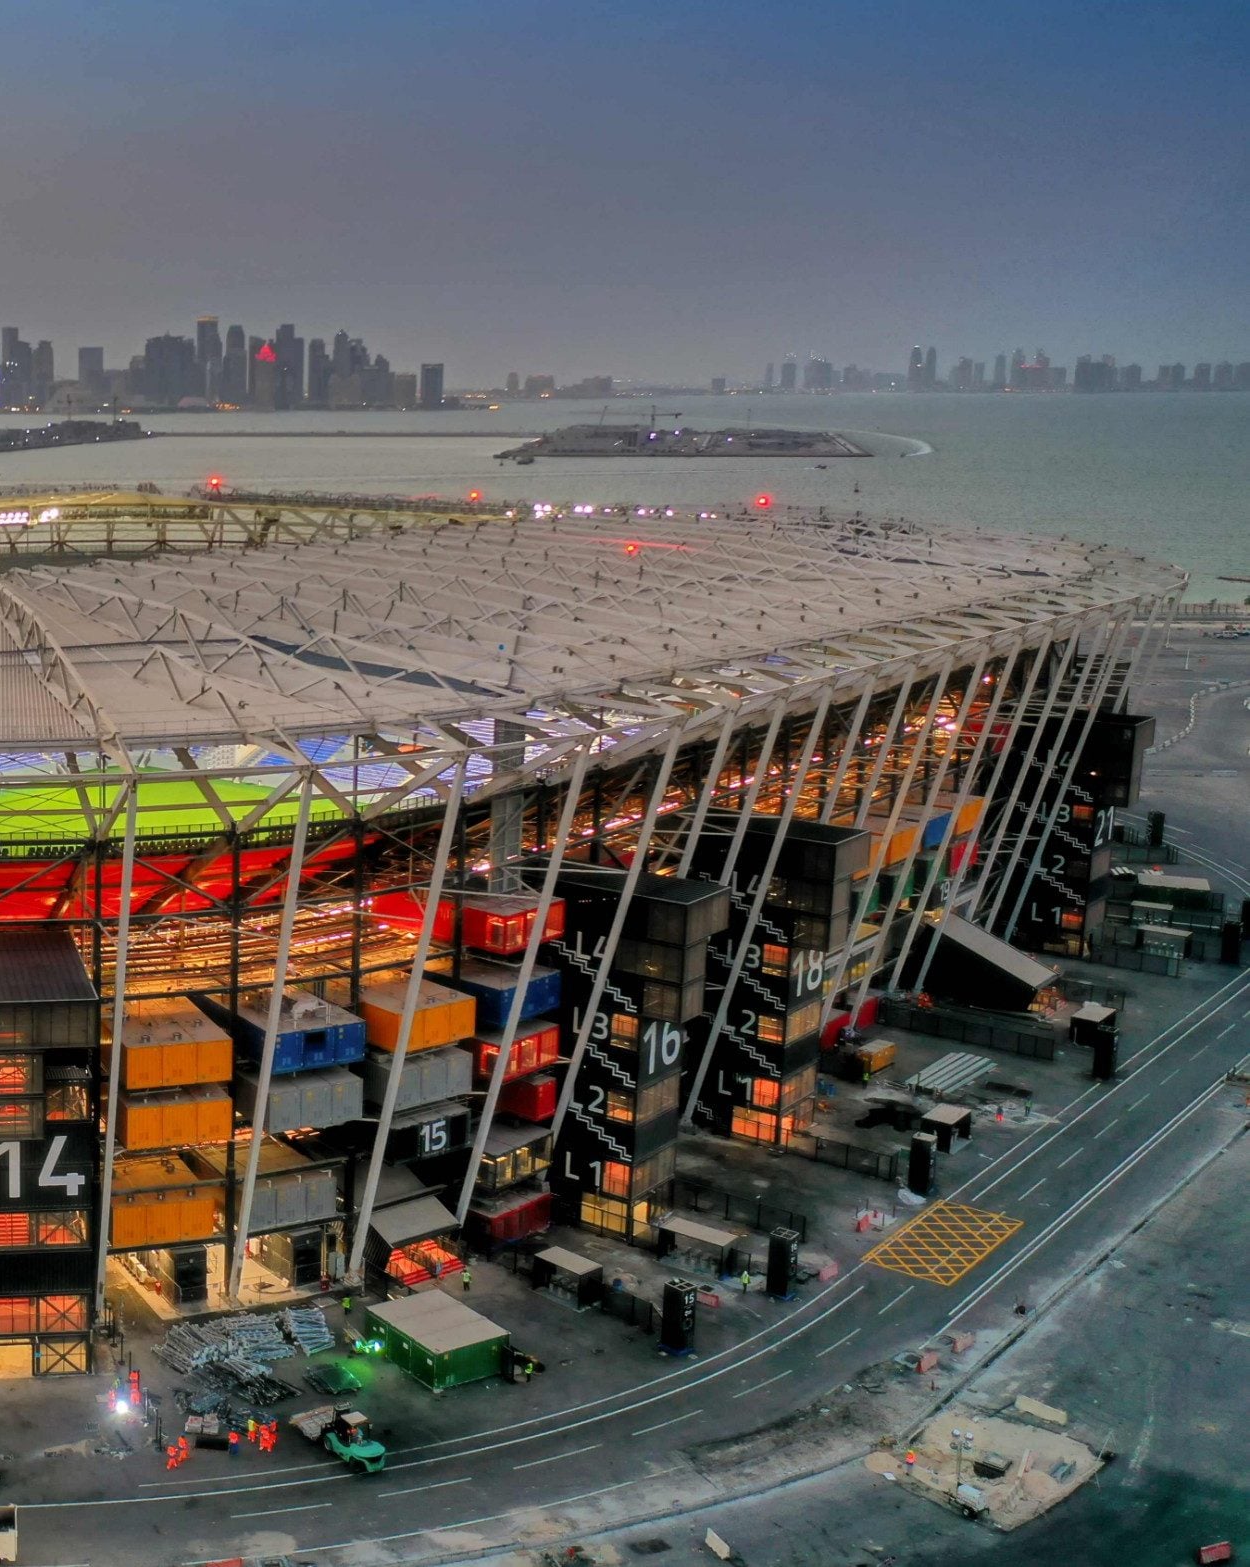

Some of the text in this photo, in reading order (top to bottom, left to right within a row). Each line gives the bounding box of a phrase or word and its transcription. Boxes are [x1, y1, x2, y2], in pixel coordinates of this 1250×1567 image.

[1094, 806, 1115, 847] 21
[793, 950, 824, 997] 18
[643, 1021, 681, 1074] 16
[420, 1120, 447, 1153] 15
[684, 1294, 695, 1304] 15
